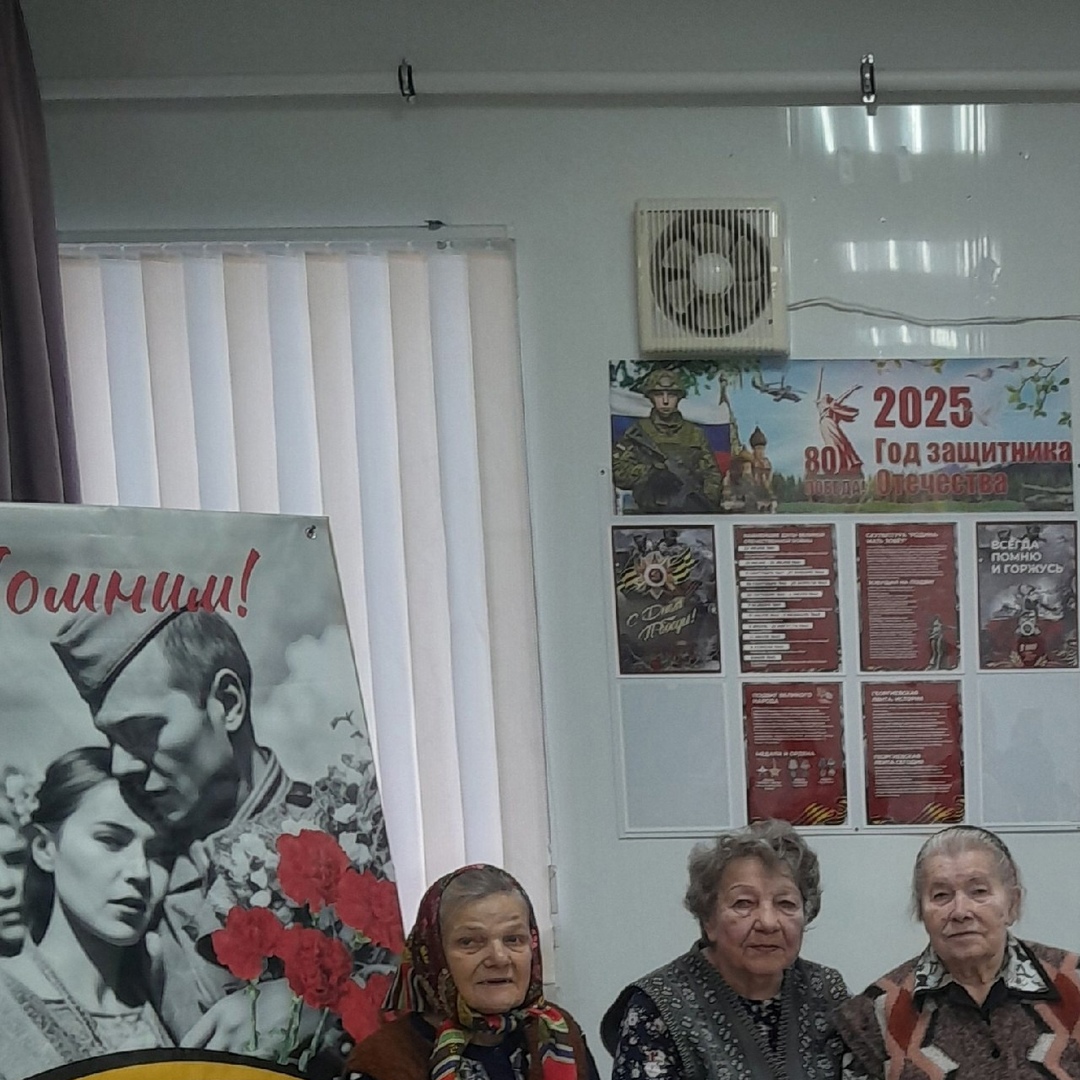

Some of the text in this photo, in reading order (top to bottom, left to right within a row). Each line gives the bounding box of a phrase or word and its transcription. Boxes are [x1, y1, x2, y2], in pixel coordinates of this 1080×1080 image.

[873, 386, 974, 428] 2025
[804, 446, 836, 475] 80
[875, 438, 1073, 467] Год защитника
[875, 469, 1008, 496] Отечества
[991, 538, 1039, 551] ВСЕГДА
[991, 552, 1042, 562] ПОМНЮ
[991, 563, 1064, 574] И ГОРЖУСЬ
